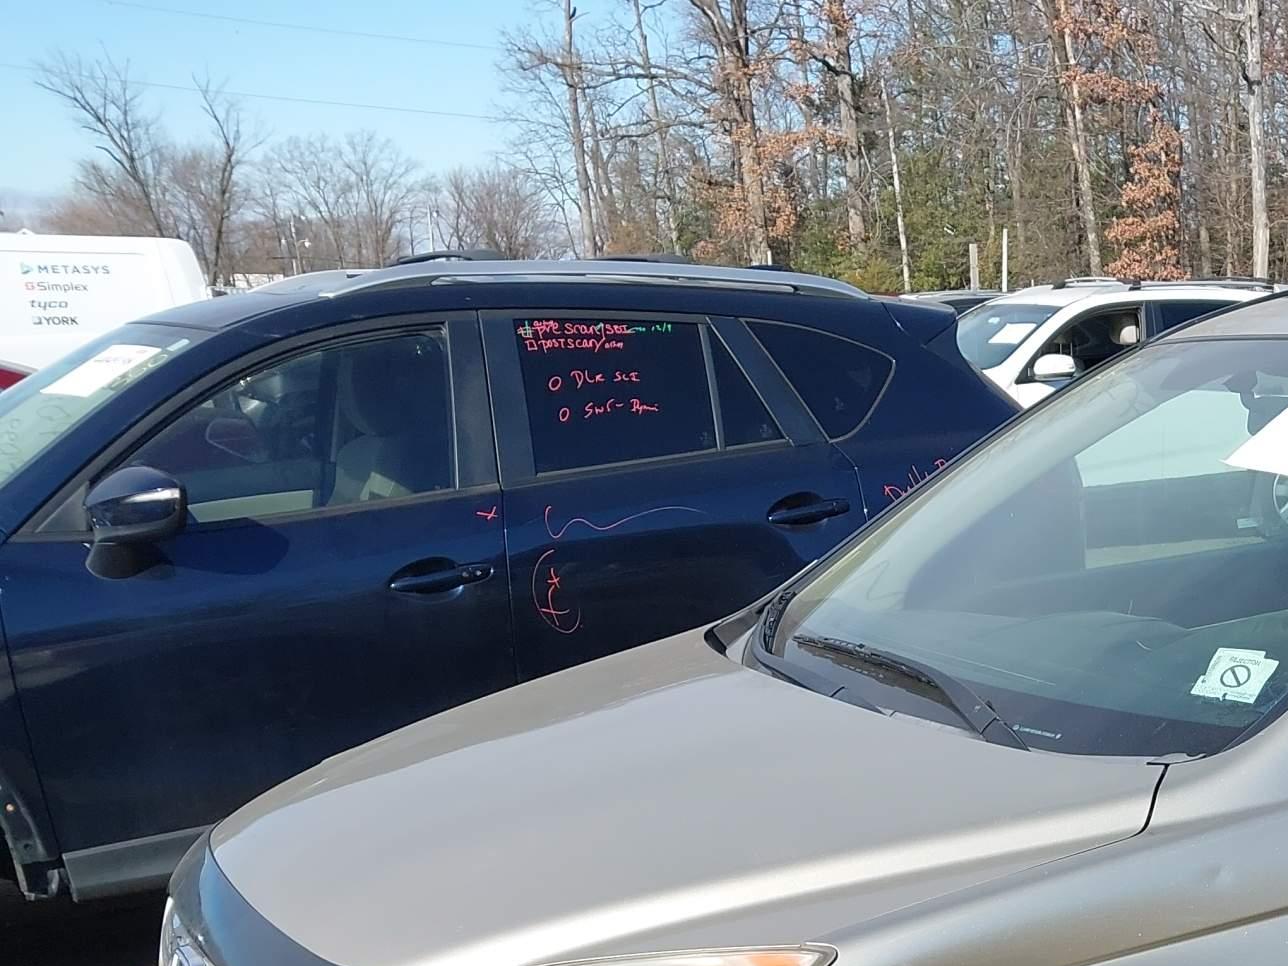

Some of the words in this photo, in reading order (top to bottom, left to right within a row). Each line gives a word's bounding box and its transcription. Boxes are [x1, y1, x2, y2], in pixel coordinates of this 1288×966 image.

[37, 264, 111, 275] METASYS
[37, 281, 89, 292] Simplex
[30, 299, 69, 311] tyco
[42, 316, 79, 326] YORK
